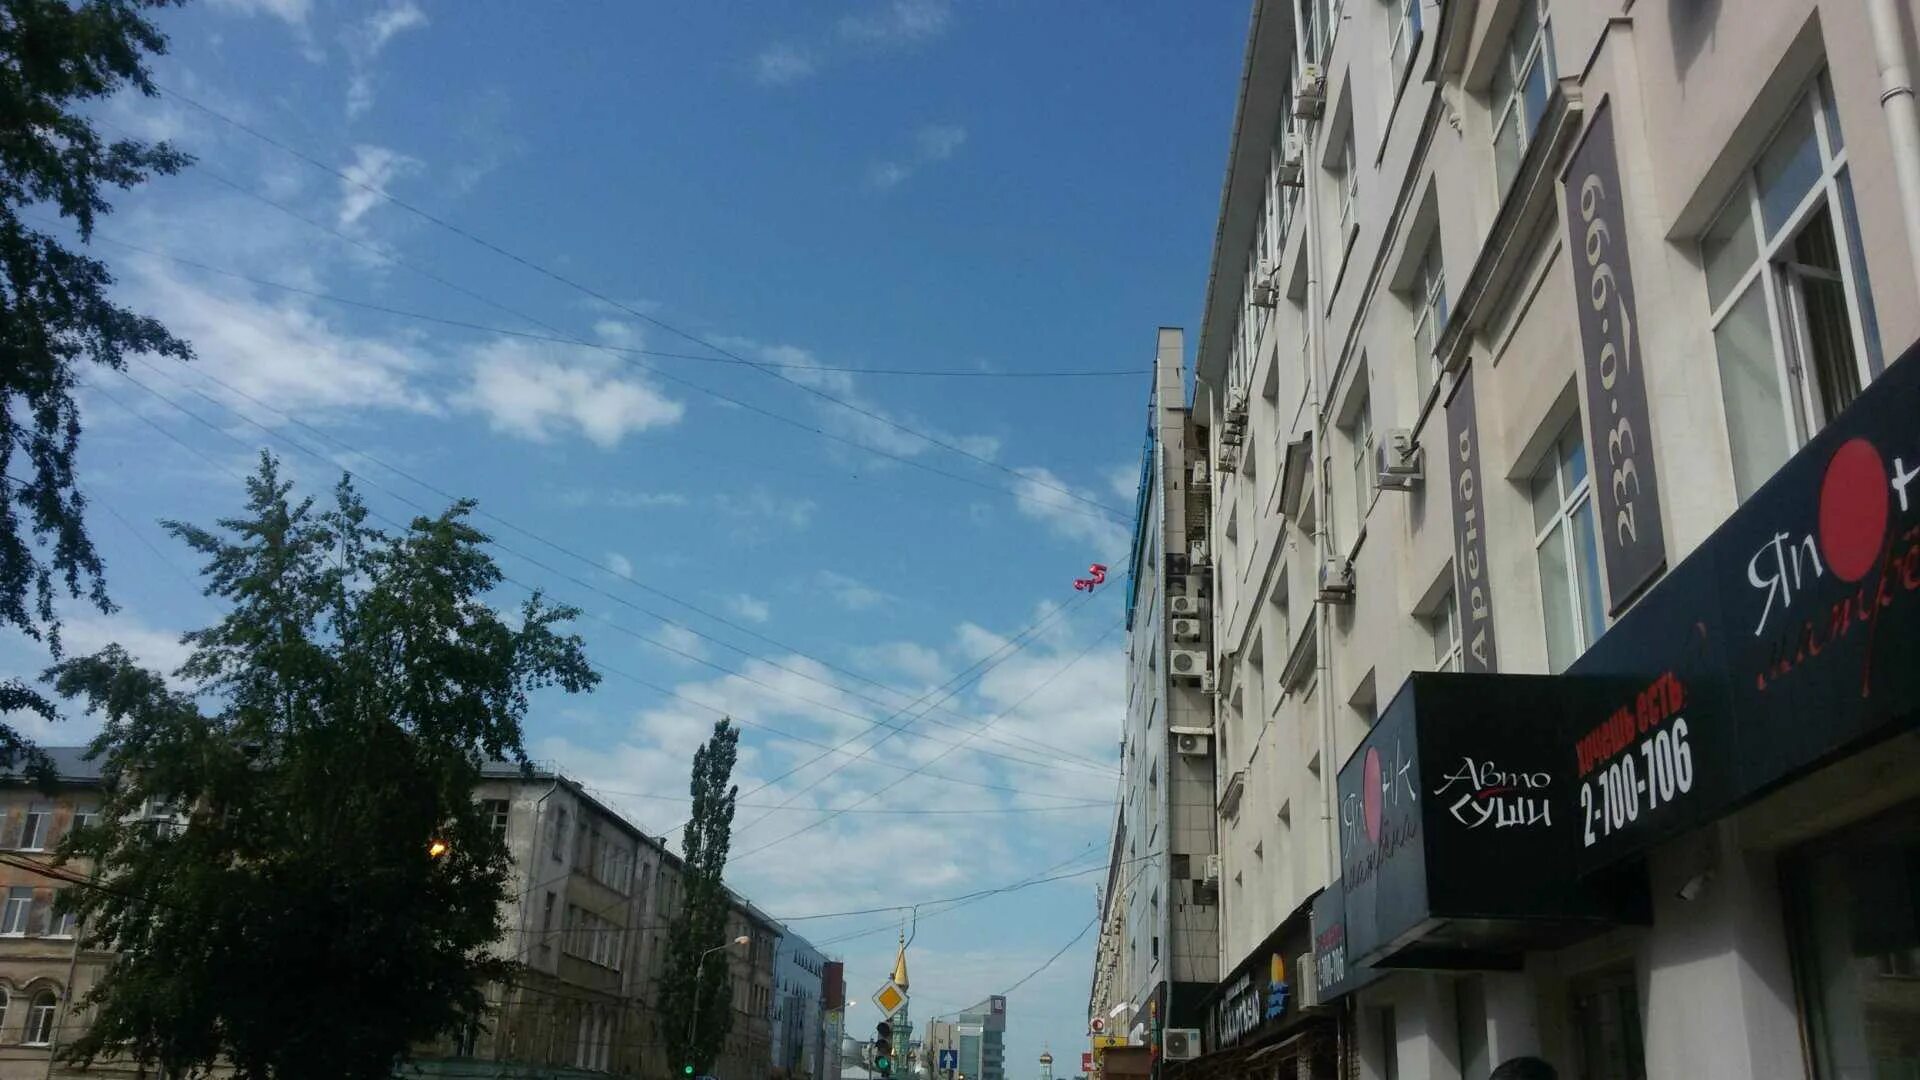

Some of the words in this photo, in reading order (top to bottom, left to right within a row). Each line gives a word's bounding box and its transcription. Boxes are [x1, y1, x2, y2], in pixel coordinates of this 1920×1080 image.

[1459, 425, 1488, 672] Аренда
[1433, 756, 1551, 796] Авто
[1581, 717, 1693, 848] 2-700-706
